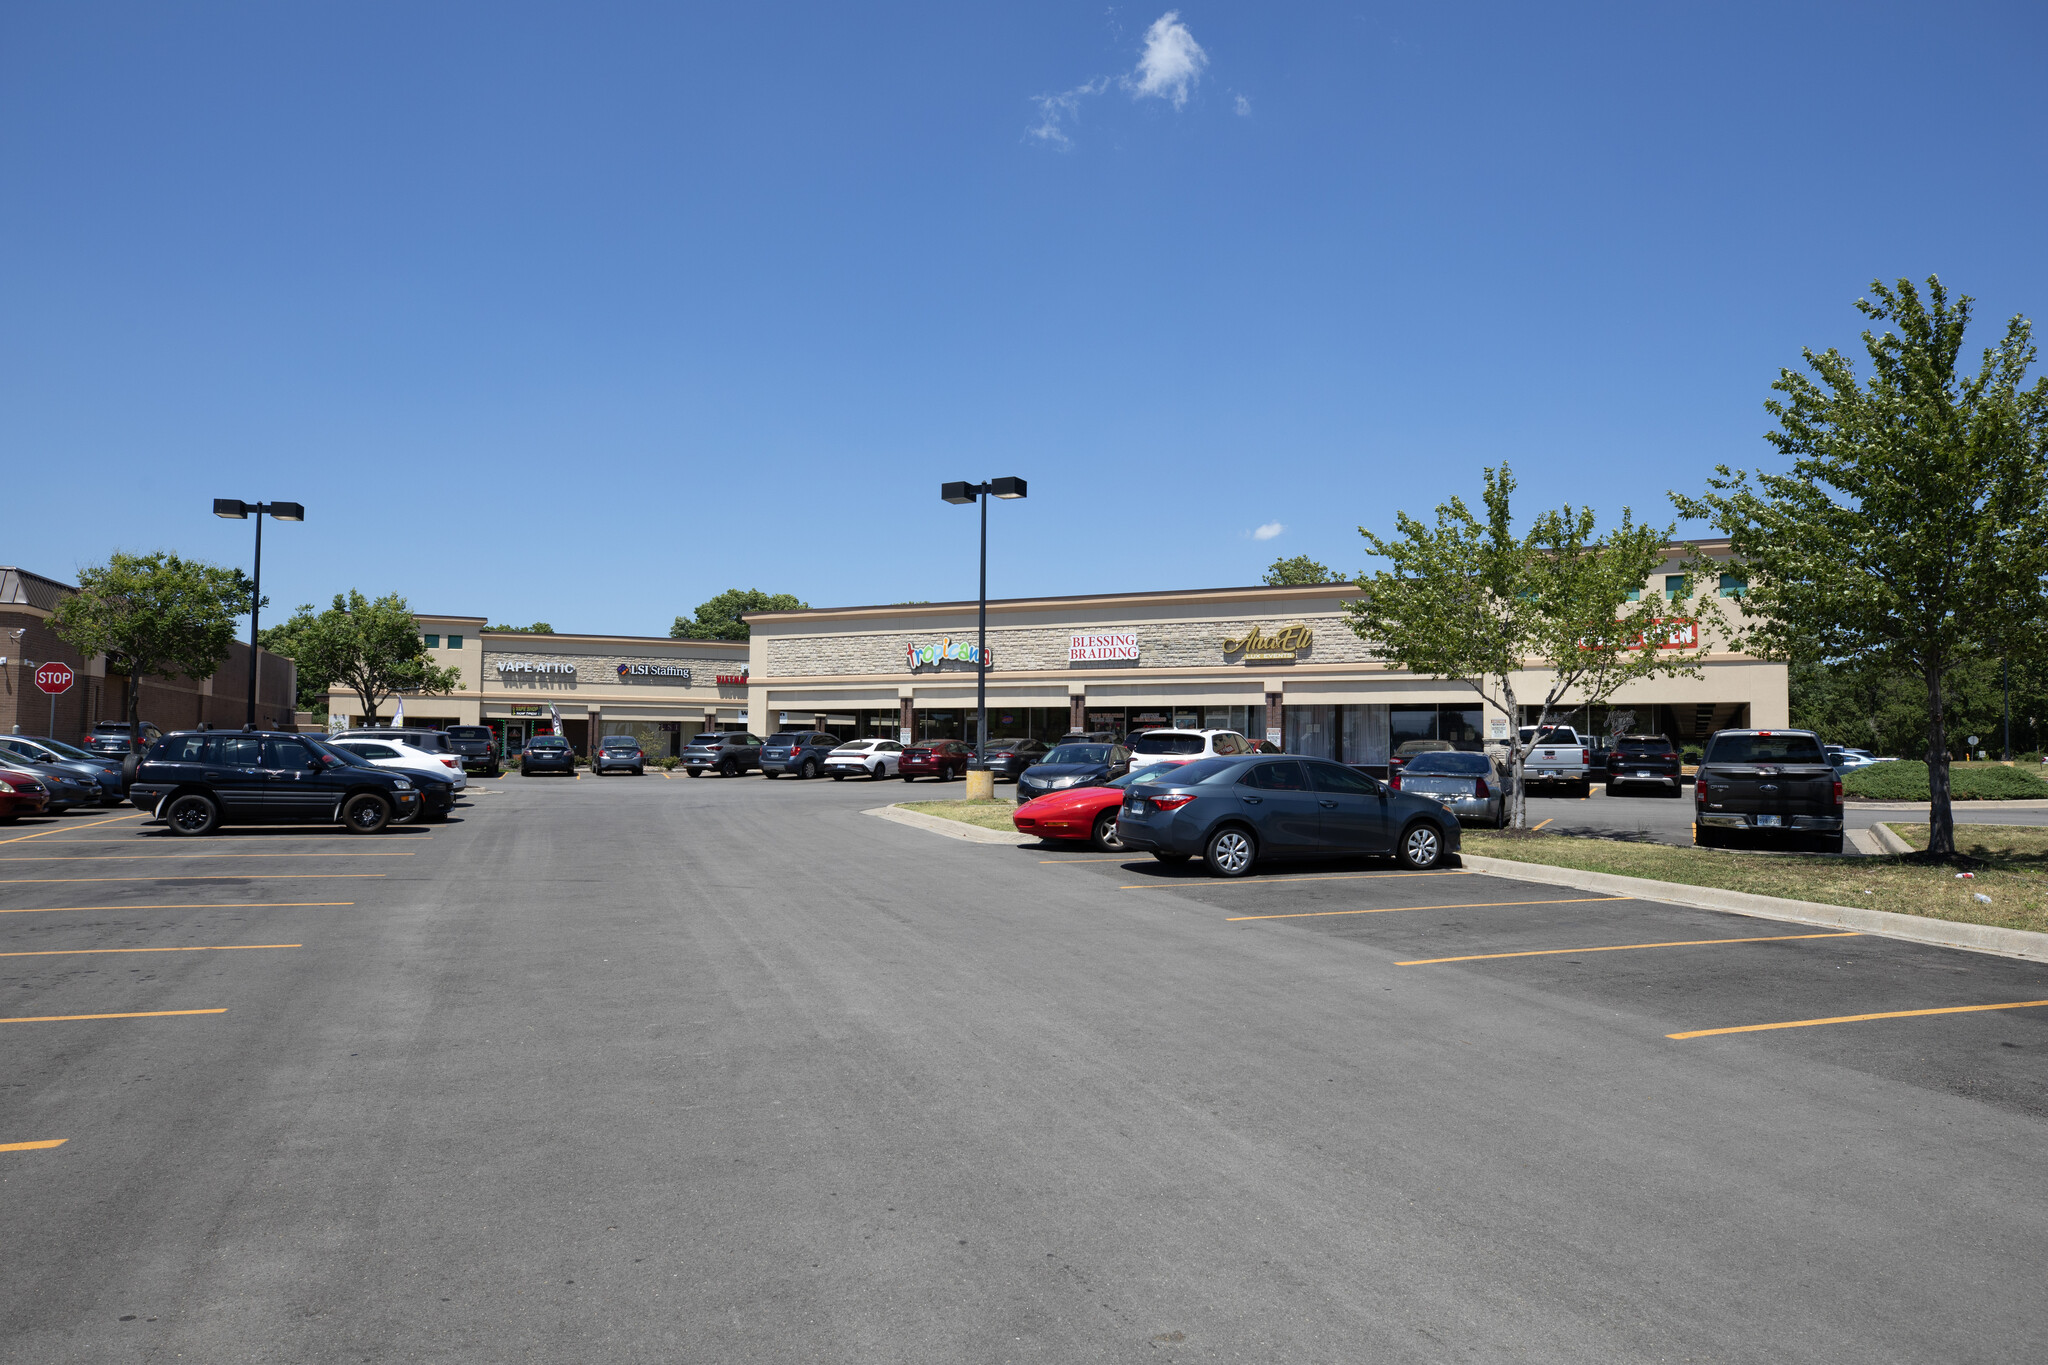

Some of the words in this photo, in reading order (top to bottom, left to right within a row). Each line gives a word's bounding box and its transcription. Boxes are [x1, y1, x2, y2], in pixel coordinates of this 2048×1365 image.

[1073, 635, 1135, 647] BLESSING
[907, 638, 991, 667] tropicana
[1070, 647, 1137, 659] BRAIDING
[497, 661, 533, 673] VAPE
[536, 663, 575, 674] ATTIC
[631, 665, 649, 675] LSI
[651, 666, 690, 678] Staffing
[38, 672, 71, 684] STOP
